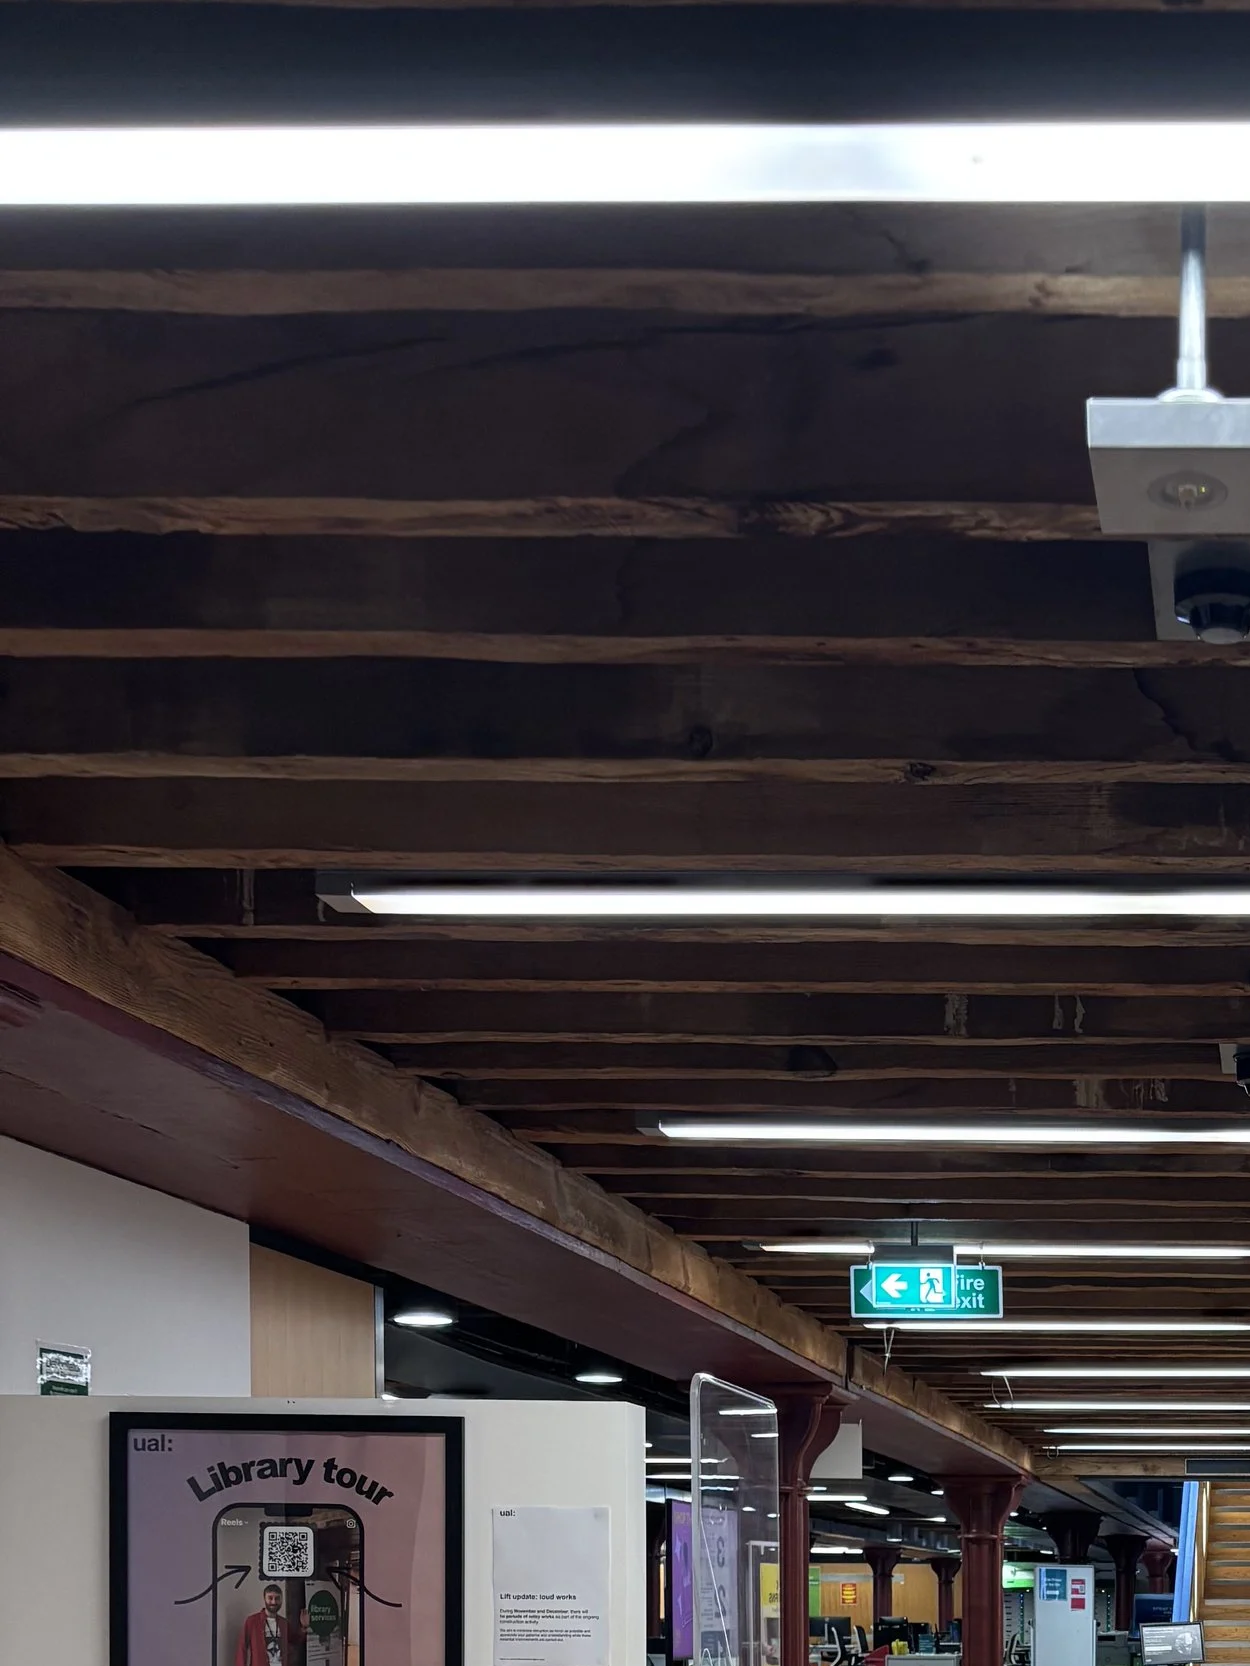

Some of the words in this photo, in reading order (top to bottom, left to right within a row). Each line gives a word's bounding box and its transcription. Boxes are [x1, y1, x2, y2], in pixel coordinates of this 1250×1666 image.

[956, 1275, 985, 1290] ire
[956, 1293, 985, 1308] xit
[133, 1434, 172, 1452] ual:
[187, 1456, 315, 1502] Library
[323, 1457, 394, 1506] tour
[221, 1518, 243, 1526] Reels
